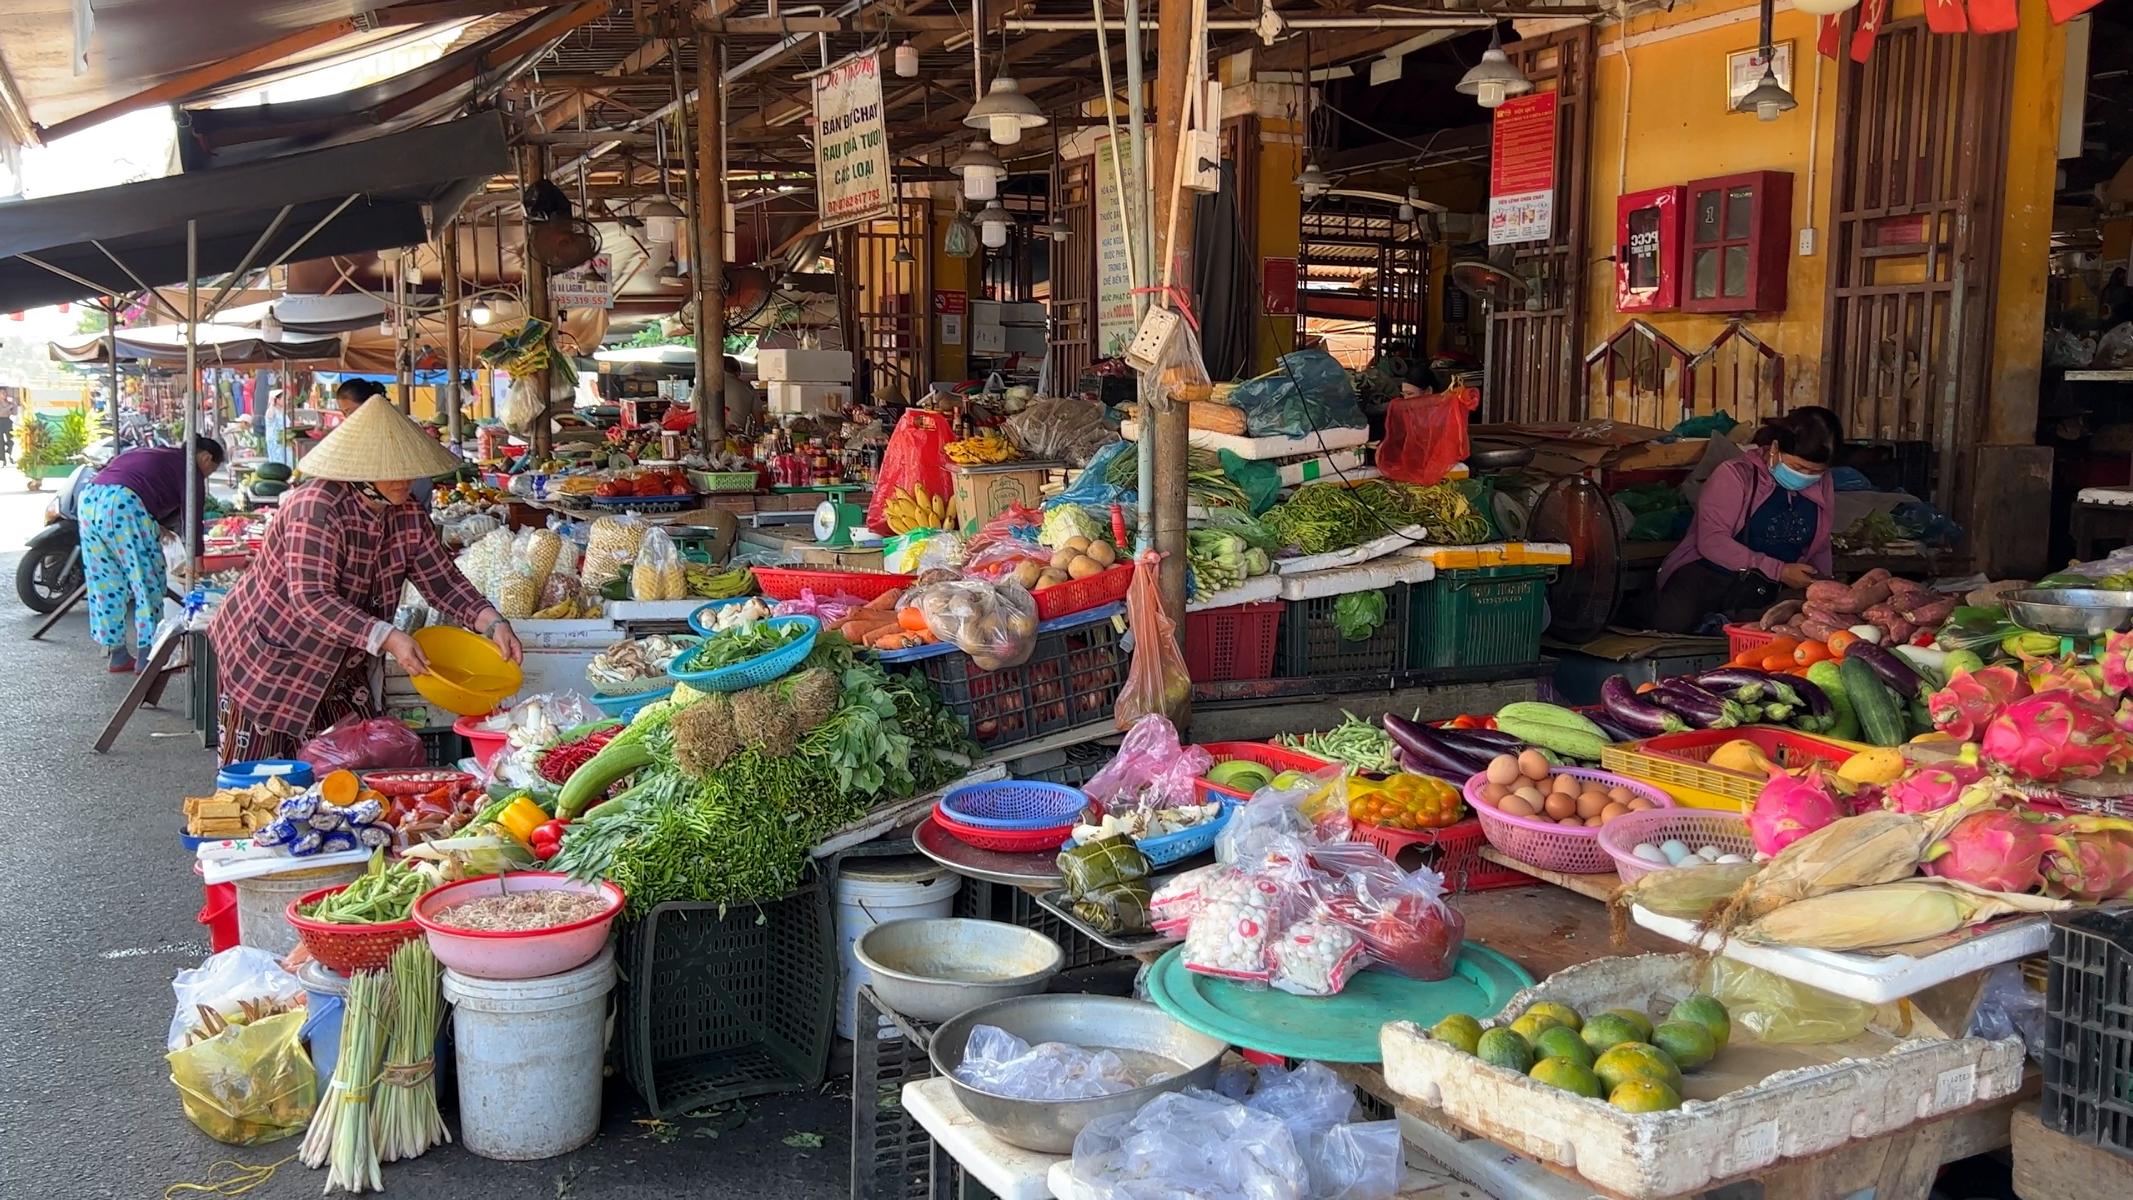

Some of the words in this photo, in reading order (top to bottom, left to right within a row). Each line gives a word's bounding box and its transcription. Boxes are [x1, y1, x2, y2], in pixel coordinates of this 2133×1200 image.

[822, 115, 842, 136] BÁN
[853, 102, 878, 124] CHAY
[823, 143, 842, 163] RAU
[852, 158, 874, 180] LOẠI
[1704, 206, 1715, 224] 1
